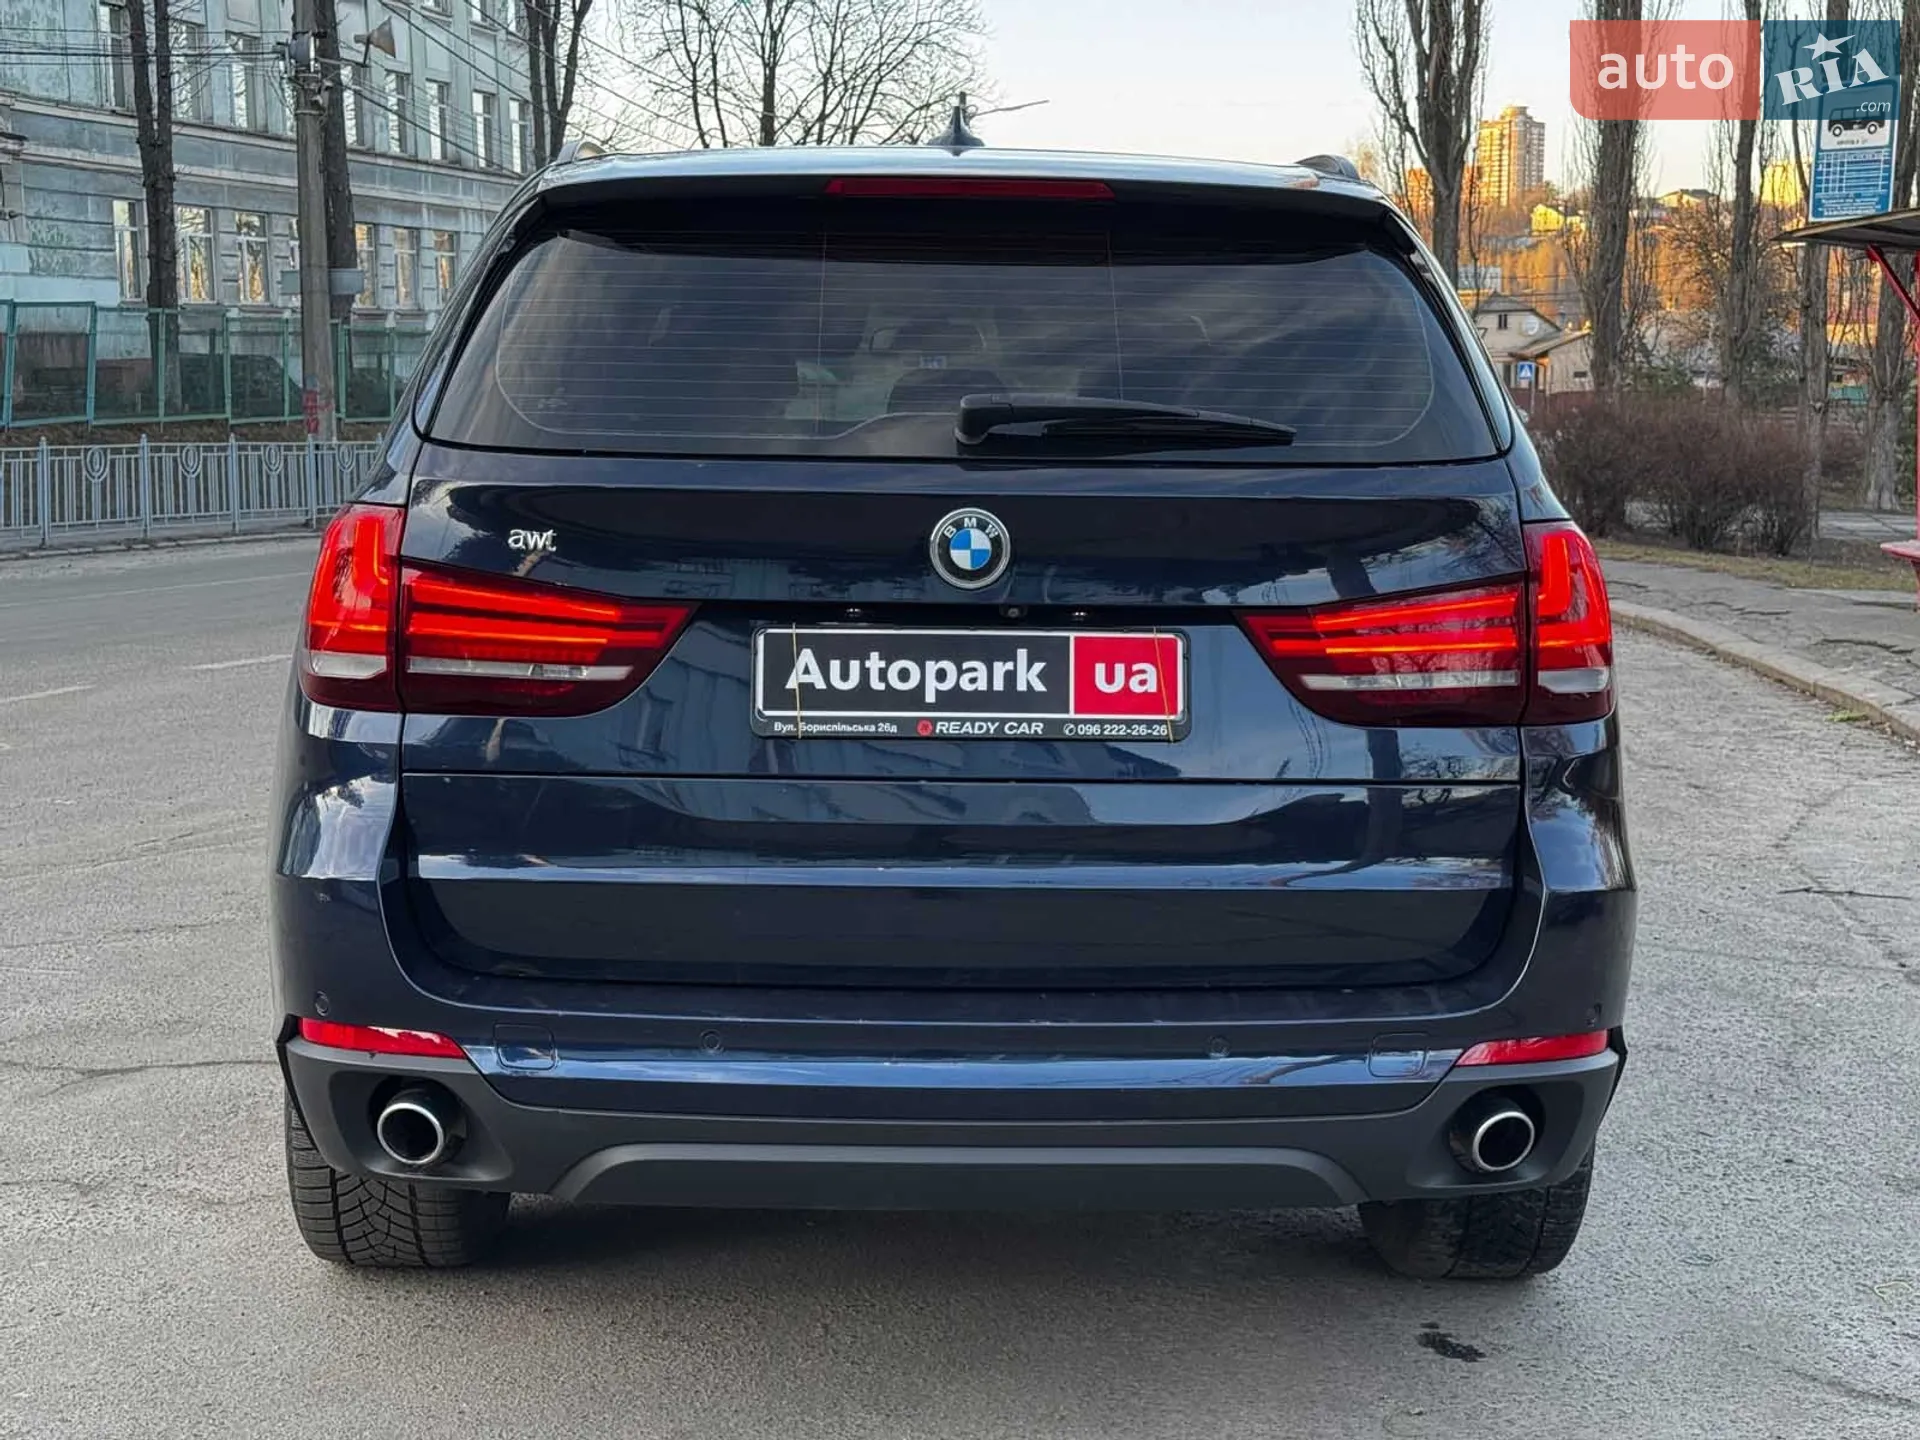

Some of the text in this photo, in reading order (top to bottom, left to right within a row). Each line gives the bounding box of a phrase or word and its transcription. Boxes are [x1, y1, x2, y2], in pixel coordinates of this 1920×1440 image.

[943, 517, 999, 539] BMW
[785, 647, 1158, 703] Autopark ua
[877, 722, 898, 734] 26д
[935, 721, 1044, 735] READY CAR
[1077, 723, 1169, 737] 096 222-26-26
